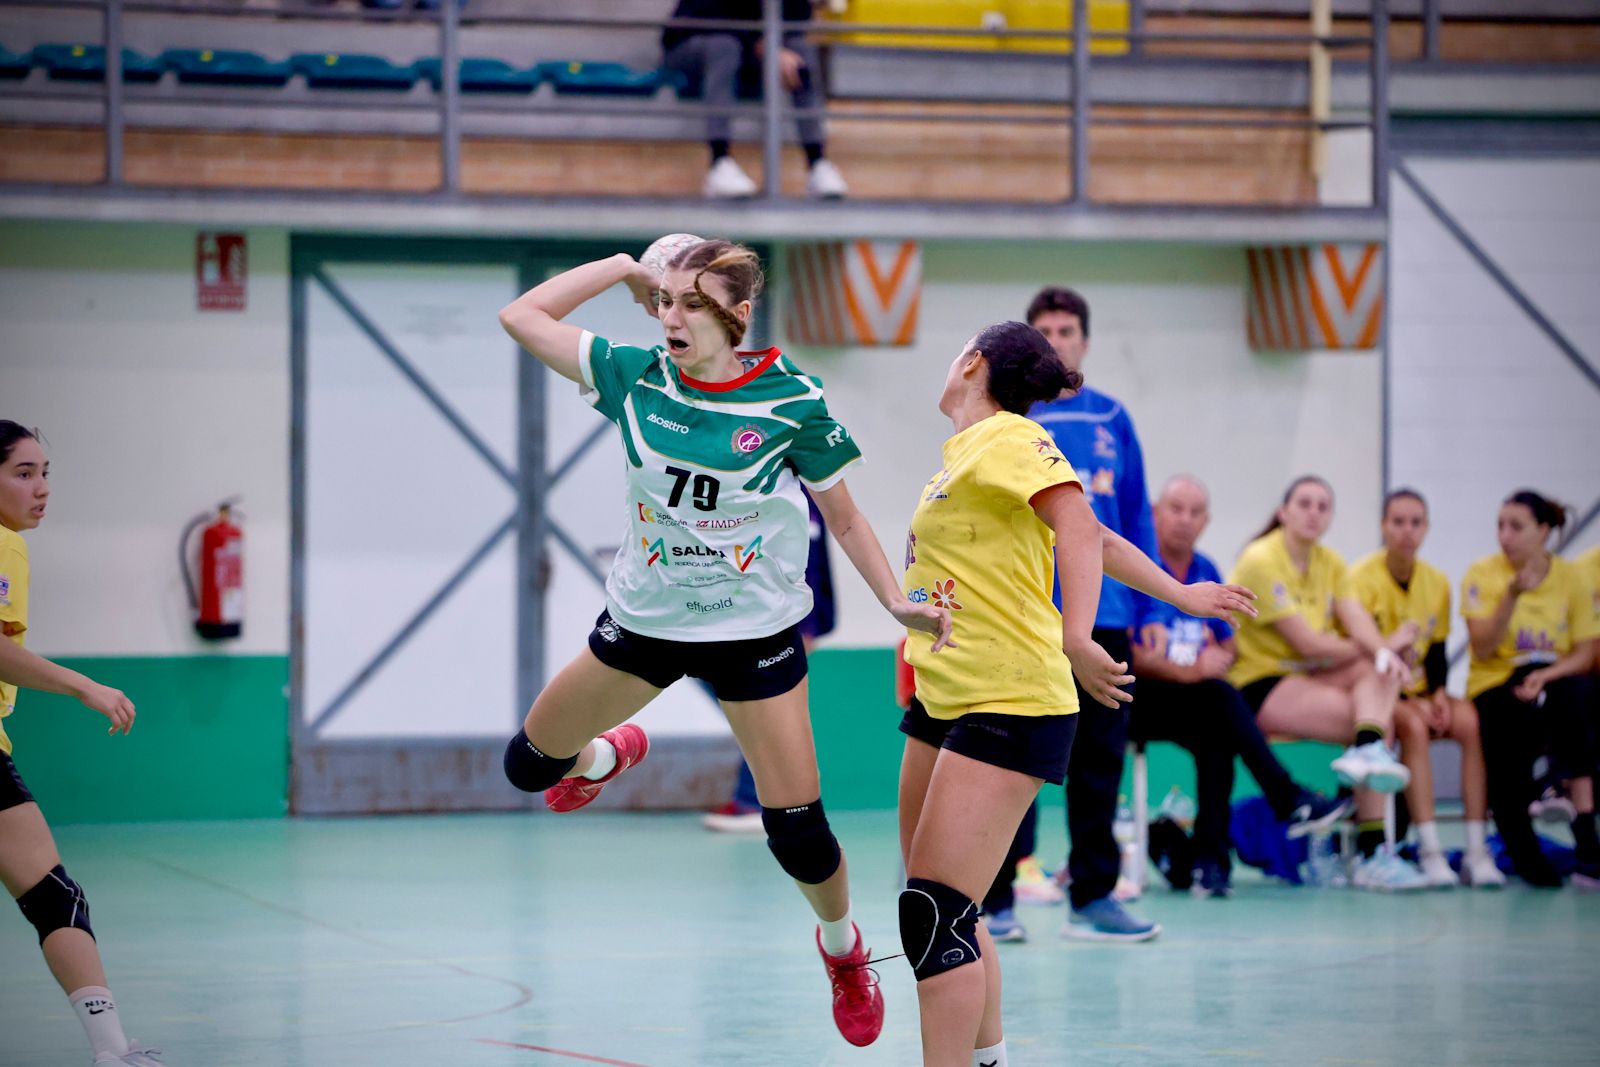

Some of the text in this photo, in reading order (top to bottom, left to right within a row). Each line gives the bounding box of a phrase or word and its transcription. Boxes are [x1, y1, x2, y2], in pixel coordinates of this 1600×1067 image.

[646, 412, 689, 434] Mosttro
[665, 465, 720, 511] 79
[686, 597, 733, 613] efficold
